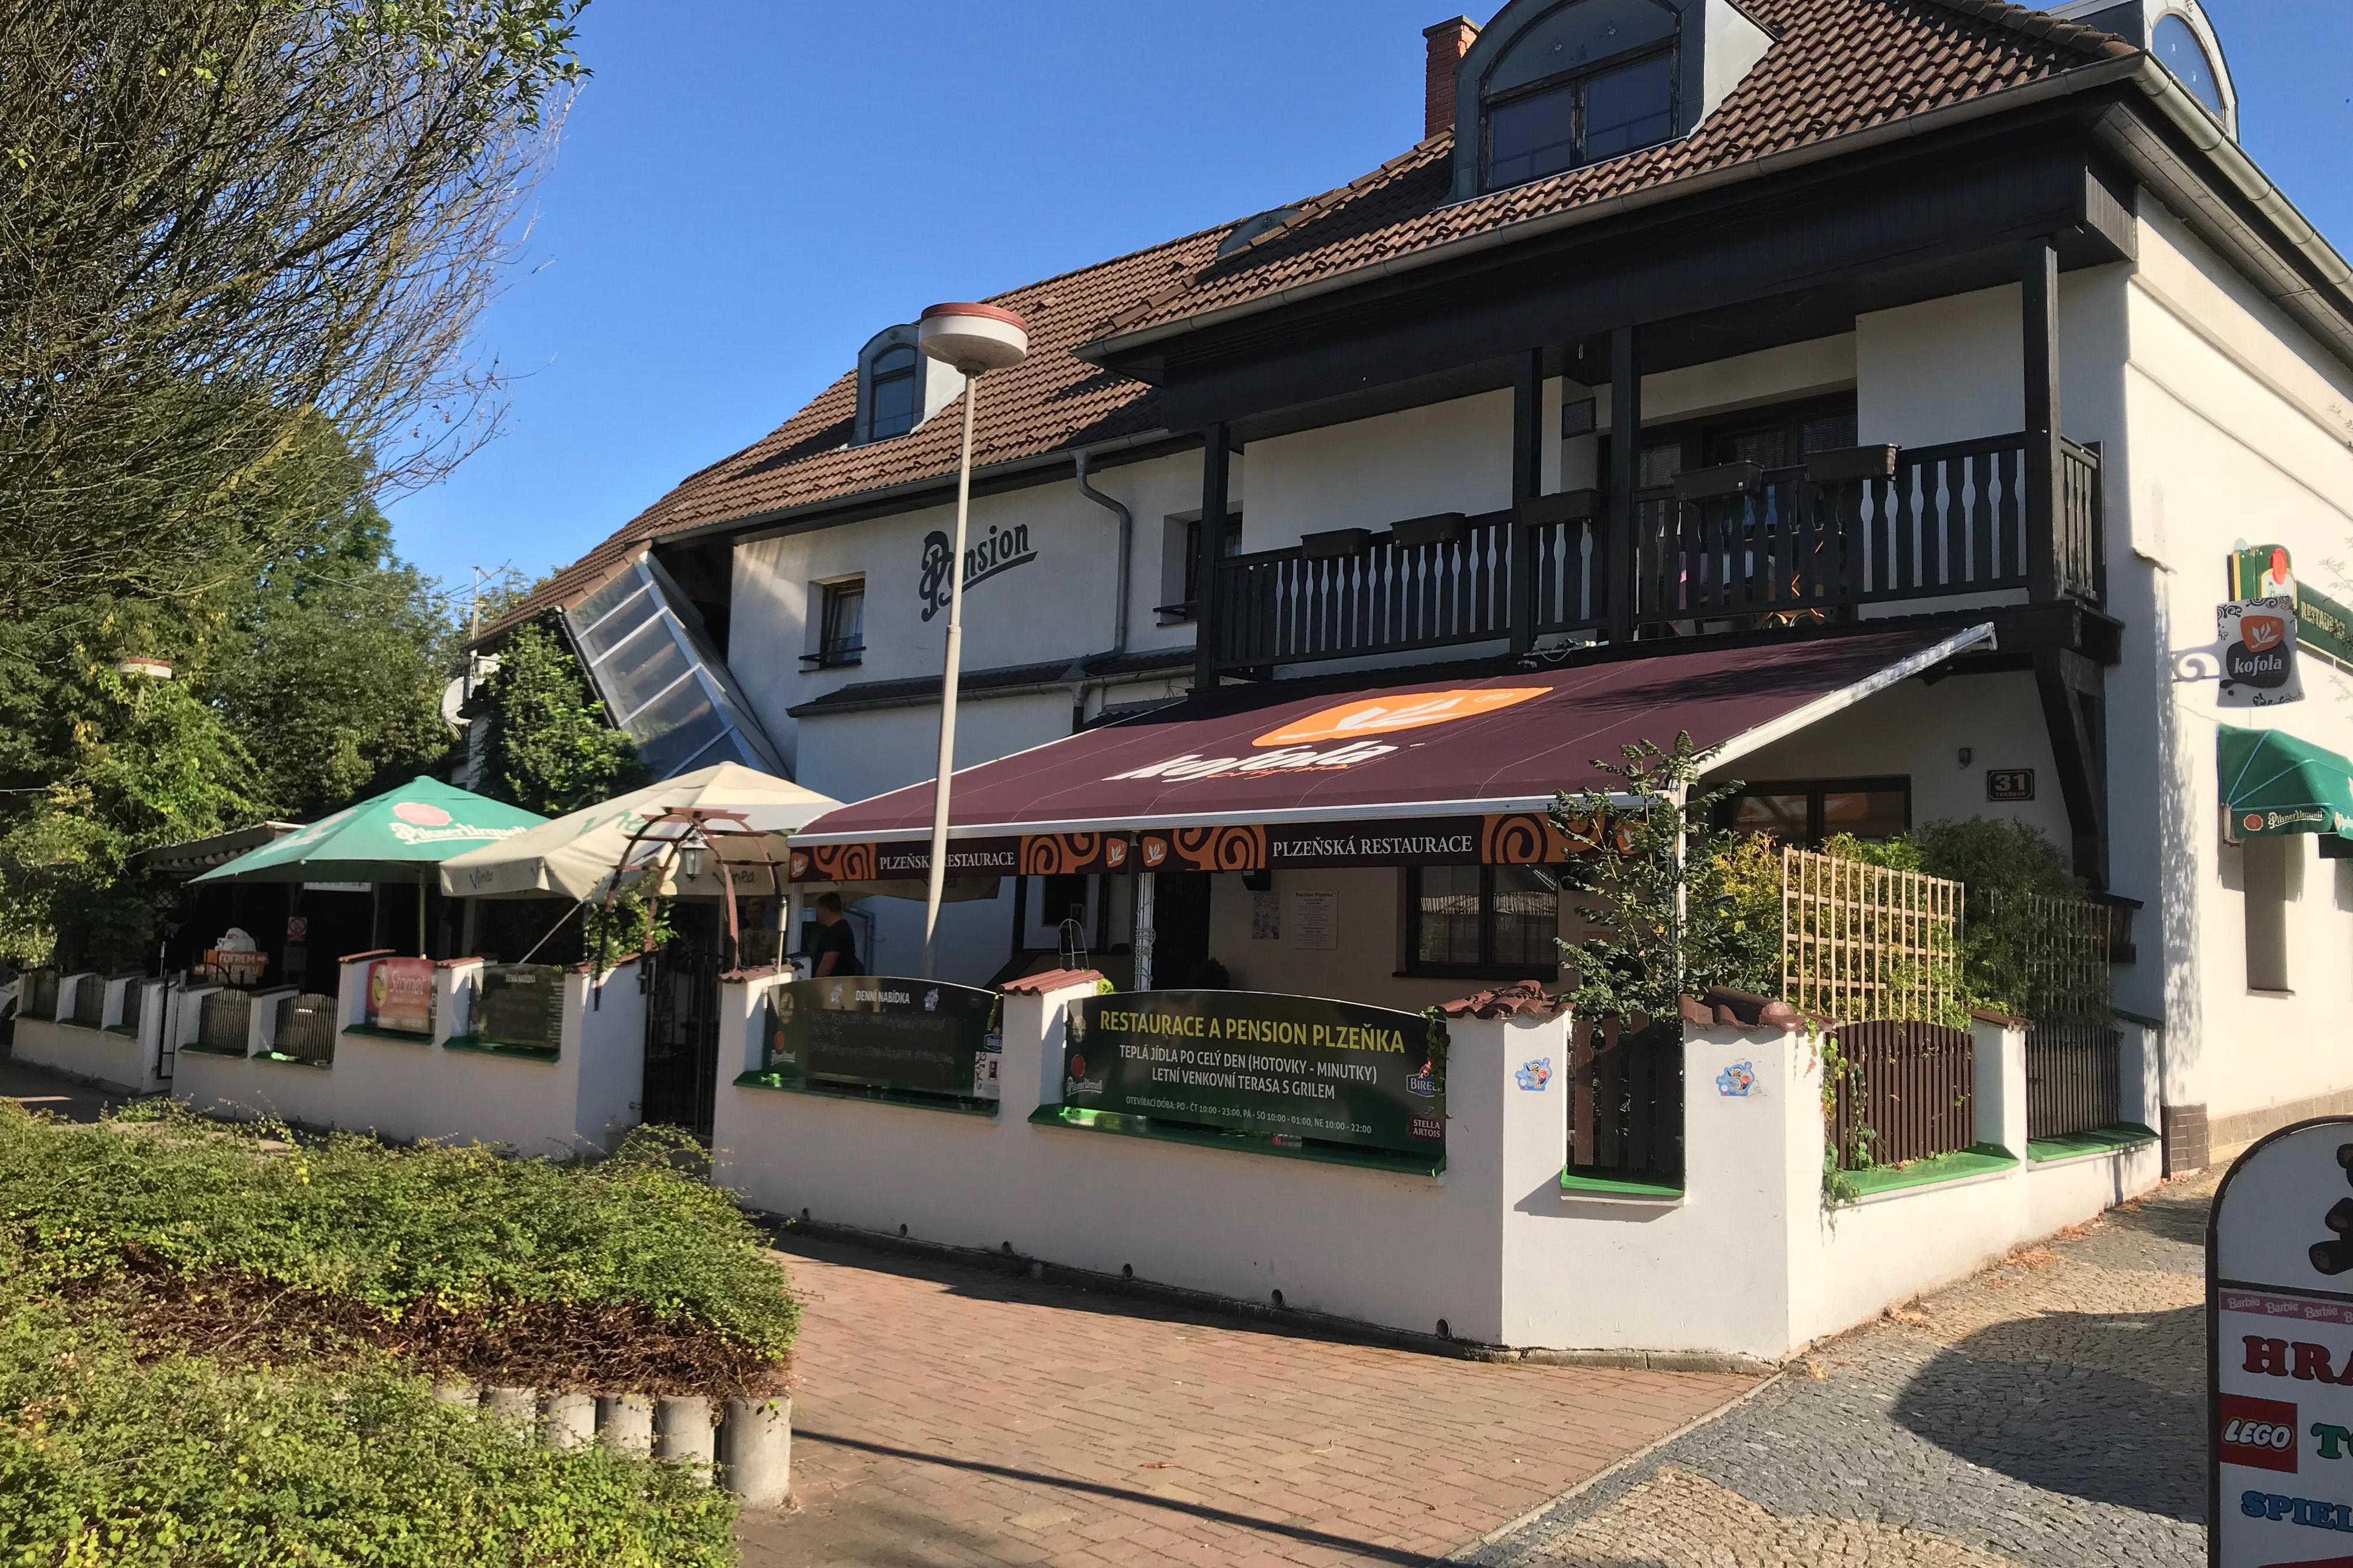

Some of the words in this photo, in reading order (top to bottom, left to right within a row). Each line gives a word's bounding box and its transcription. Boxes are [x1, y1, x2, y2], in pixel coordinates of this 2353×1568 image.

[2234, 654, 2282, 677] kofola
[1101, 740, 1399, 783] kofola
[1995, 774, 2025, 791] 31
[2268, 812, 2297, 829] Pilsner
[2295, 809, 2323, 822] Urquell
[1272, 835, 1357, 857] PLZEŇSKÁ
[1360, 836, 1472, 855] RESTAURACE
[879, 852, 931, 870] PLZEŇSK
[945, 852, 1015, 868] ESTAURACE
[712, 870, 755, 888] Vnea
[855, 989, 878, 1002] DENNÍ
[878, 990, 910, 1004] NABÍDKA
[1100, 1010, 1205, 1037] RESTAURACE
[1208, 1017, 1222, 1039] A
[1225, 1019, 1306, 1045] PENSION
[1313, 1023, 1405, 1053] PLZEŇKA
[1119, 1045, 1149, 1060] TEPLÁ
[1150, 1045, 1178, 1063] JÍDLA
[1180, 1050, 1195, 1064] PO
[1197, 1050, 1221, 1066] CELÝ
[1224, 1053, 1246, 1069] DEN
[1248, 1055, 1307, 1075] (HOTOVKY
[1317, 1062, 1377, 1085] MINUTKY)
[1152, 1067, 1180, 1083] LETNÍ
[1182, 1070, 1236, 1089] VENKOVNÍ
[1238, 1075, 1280, 1093] TERASA
[1282, 1080, 1289, 1094] S
[1292, 1081, 1335, 1100] GRILEM
[1176, 1102, 1185, 1110] PO
[1190, 1102, 1198, 1112] ČT
[1199, 1105, 1217, 1115] 10:00
[1243, 1108, 1251, 1118] PÁ
[1257, 1111, 1265, 1120] SO
[1267, 1113, 1286, 1123] 10:00
[1291, 1116, 1313, 1127] 01:00,
[1315, 1118, 1324, 1127] NE
[1325, 1120, 1345, 1130] 10:00
[1351, 1123, 1372, 1133] 22:00
[1413, 1119, 1441, 1129] STELLA
[1412, 1127, 1441, 1138] ARTOIS
[2228, 1297, 2261, 1309] Barbie
[2265, 1302, 2299, 1314] Barbie
[2304, 1306, 2338, 1318] Barbie
[2224, 1419, 2292, 1450] LEGO
[2310, 1422, 2353, 1460] T
